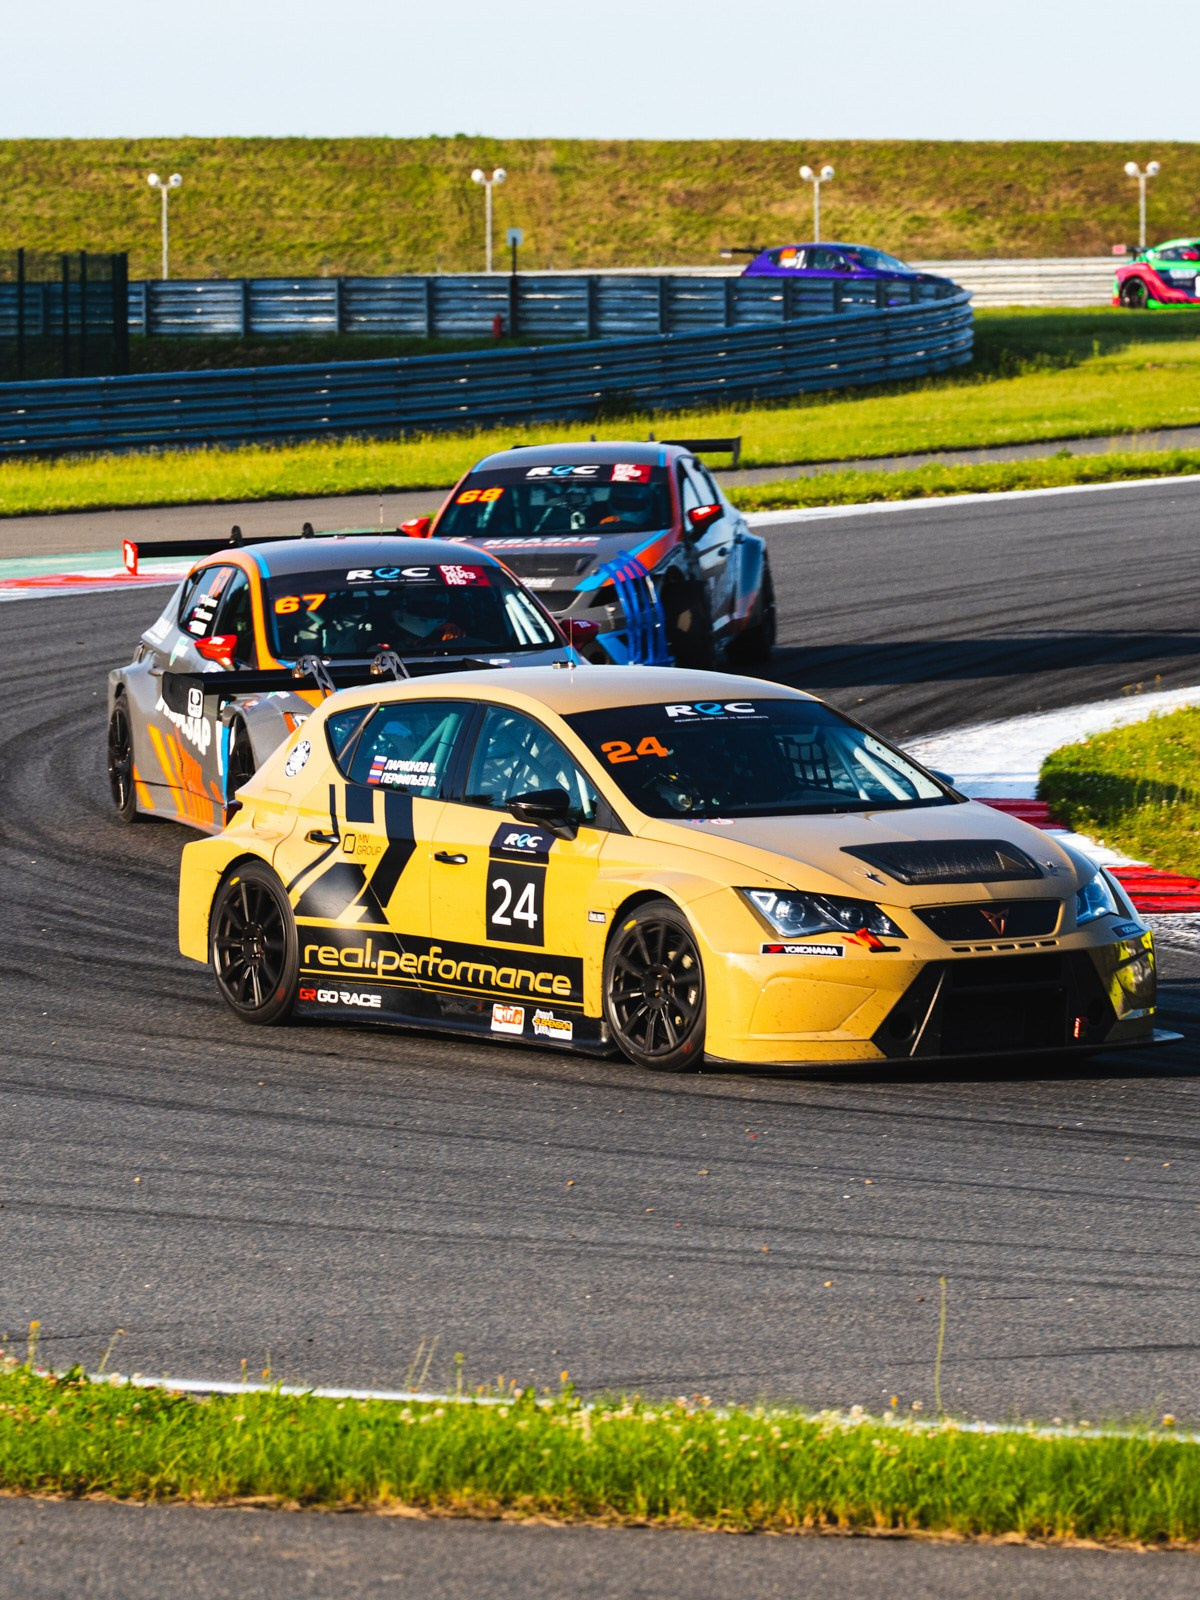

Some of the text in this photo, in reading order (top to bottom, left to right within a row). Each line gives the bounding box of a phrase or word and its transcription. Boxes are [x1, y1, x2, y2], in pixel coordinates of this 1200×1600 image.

[456, 487, 504, 504] 68
[274, 593, 327, 614] 67
[600, 736, 669, 764] 24
[384, 759, 429, 773] ЛАРИОНОВ
[357, 845, 382, 856] GROUP
[492, 878, 538, 929] 24
[784, 946, 838, 955] YOKOHAMA
[304, 938, 572, 996] real.performance
[300, 988, 382, 1008] GR GO RACE
[533, 1017, 572, 1031] SUSPENSION
